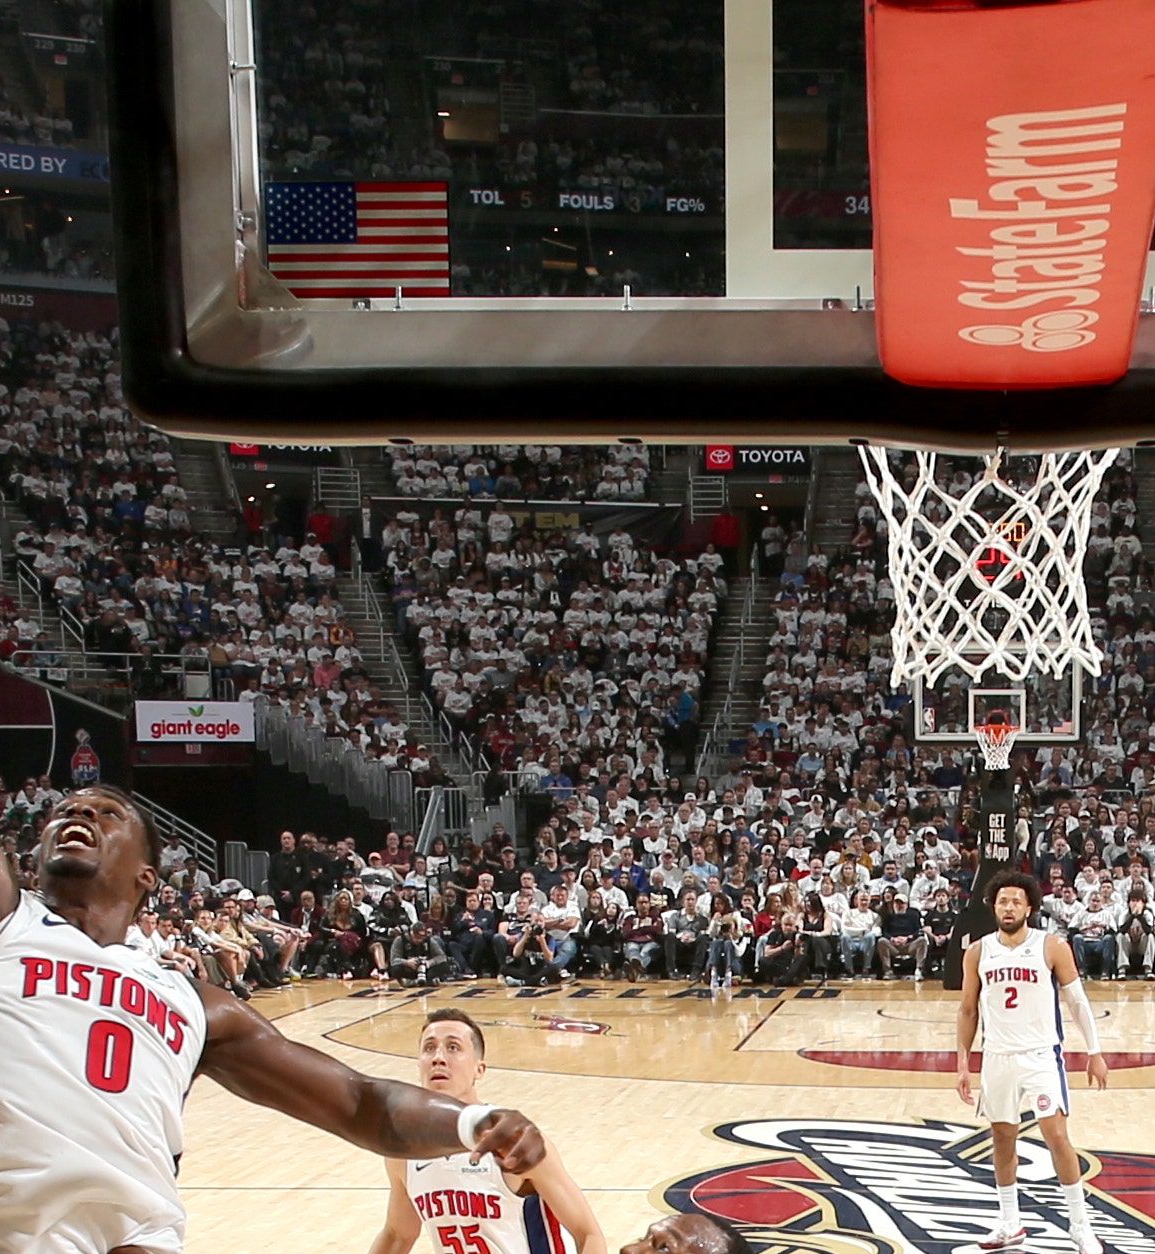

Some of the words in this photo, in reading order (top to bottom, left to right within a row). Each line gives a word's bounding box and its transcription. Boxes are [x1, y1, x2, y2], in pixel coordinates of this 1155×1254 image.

[39, 156, 67, 174] BY
[469, 188, 505, 206] TOL
[520, 191, 533, 208] 5
[558, 193, 615, 210] FOULS
[665, 196, 706, 213] FG%
[845, 195, 870, 214] 34
[0, 292, 35, 307] M125
[738, 449, 806, 463] TOYOTA
[150, 719, 193, 739] giant
[194, 718, 241, 739] eagle
[988, 813, 1006, 829] GET
[988, 828, 1006, 844] THE
[992, 845, 1010, 861] App
[984, 966, 1039, 985] PISTONS
[20, 956, 188, 1055] PISTONS
[1004, 986, 1019, 1010] 2
[84, 1018, 135, 1094] 0
[414, 1189, 502, 1221] PISTONS
